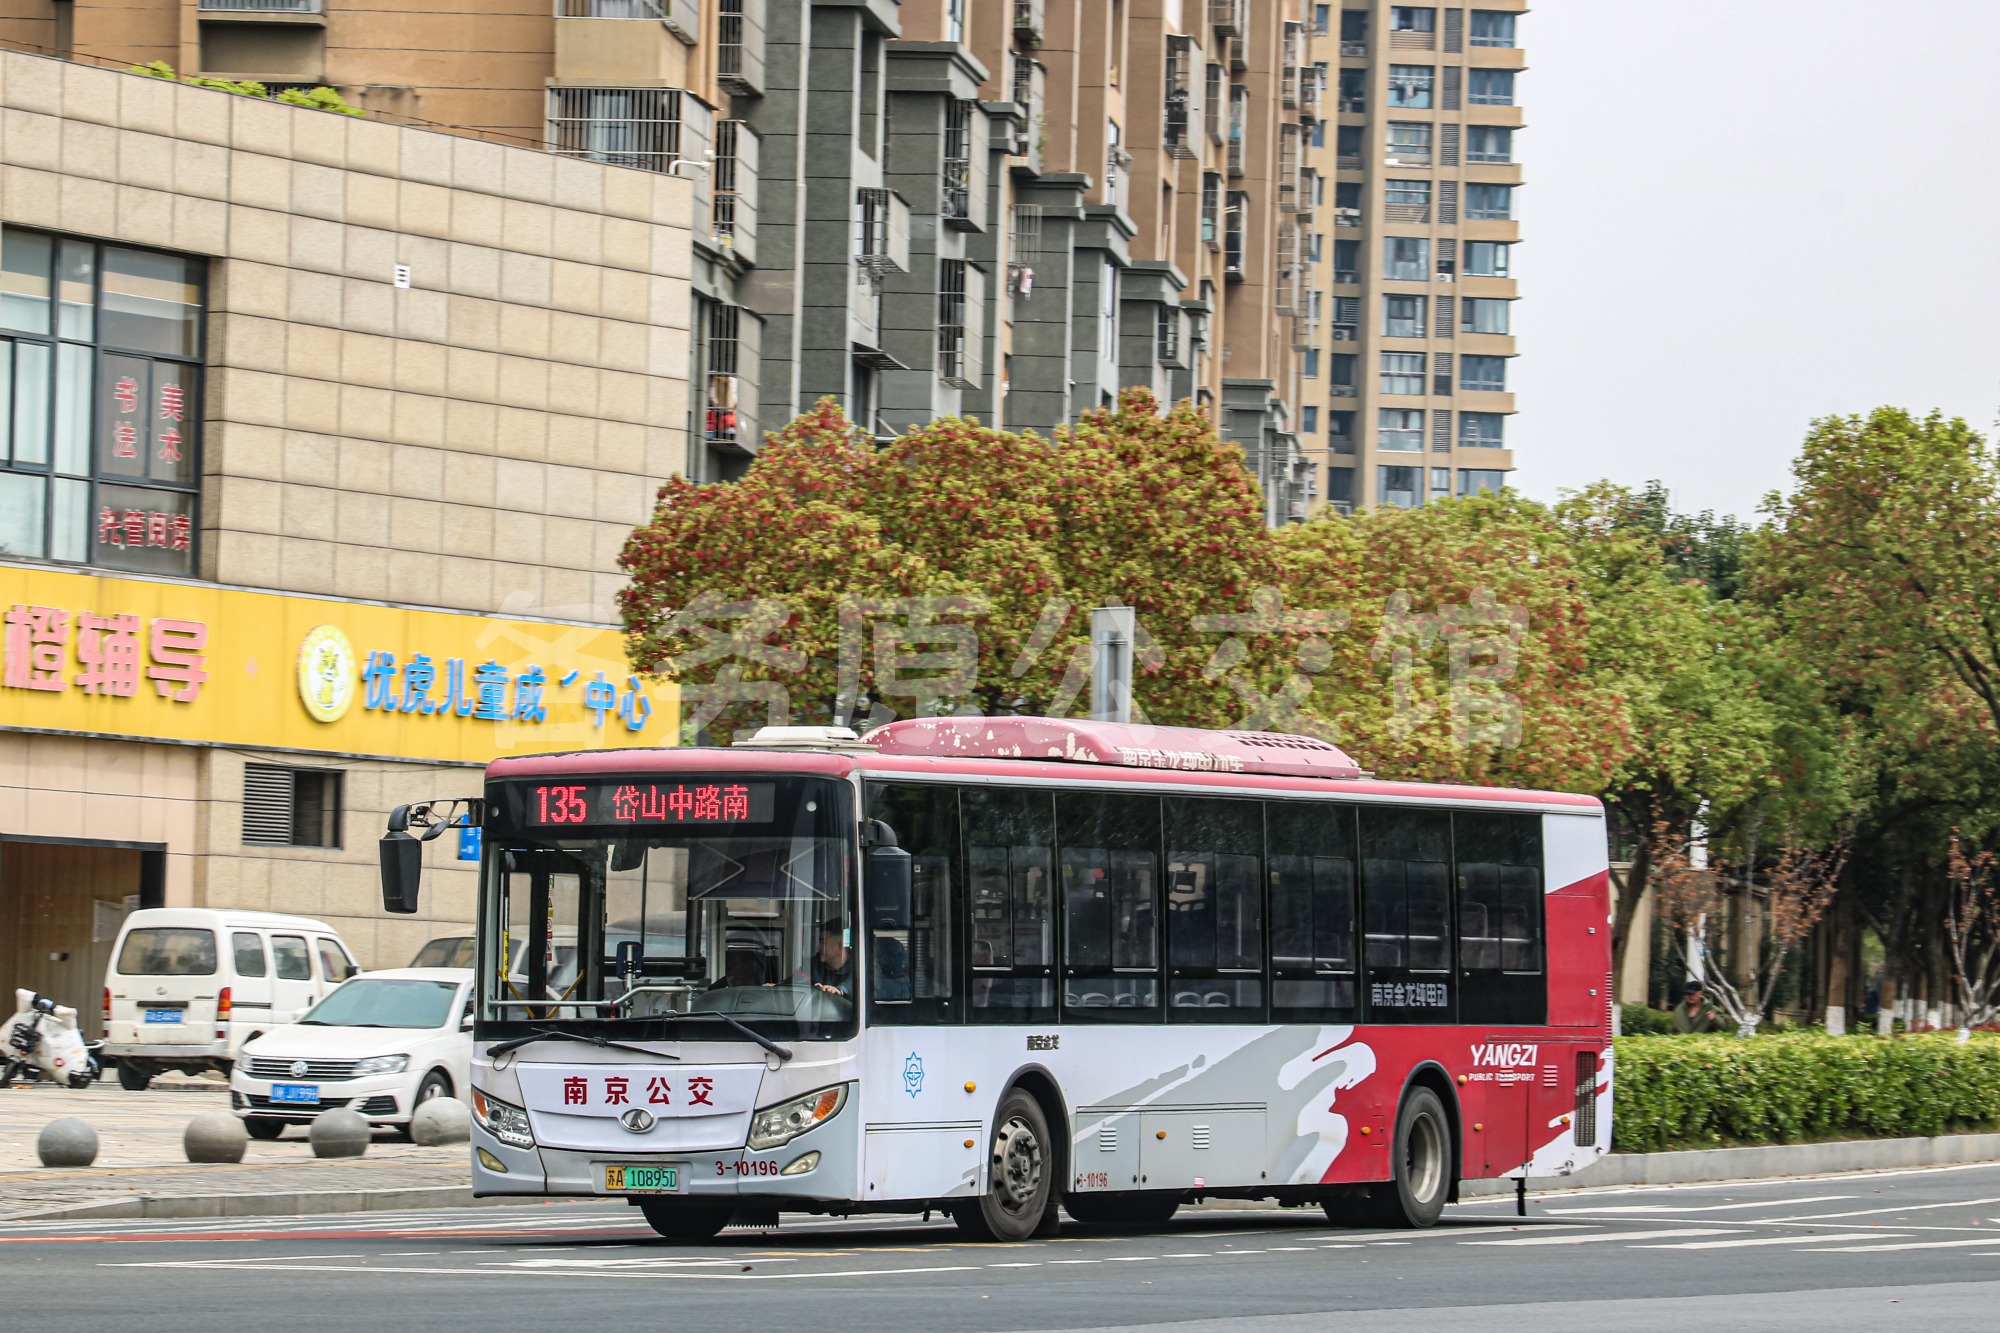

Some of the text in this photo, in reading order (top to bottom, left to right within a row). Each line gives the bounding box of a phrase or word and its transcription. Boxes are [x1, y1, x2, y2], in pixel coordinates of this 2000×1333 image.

[158, 383, 184, 464] 美术
[98, 505, 191, 551] 托管阅读
[3, 604, 209, 702] 橙辅导
[362, 651, 653, 731] 优虎儿童成中心
[536, 785, 587, 823] 135
[612, 784, 748, 822] 岱山中路南
[1372, 982, 1447, 1007] 南京金龙纯电动
[1470, 1043, 1538, 1067] YANGZI
[563, 1076, 713, 1106] 南京公交
[1468, 1073, 1494, 1082] PUBLIC
[715, 1160, 778, 1176] 3-10196
